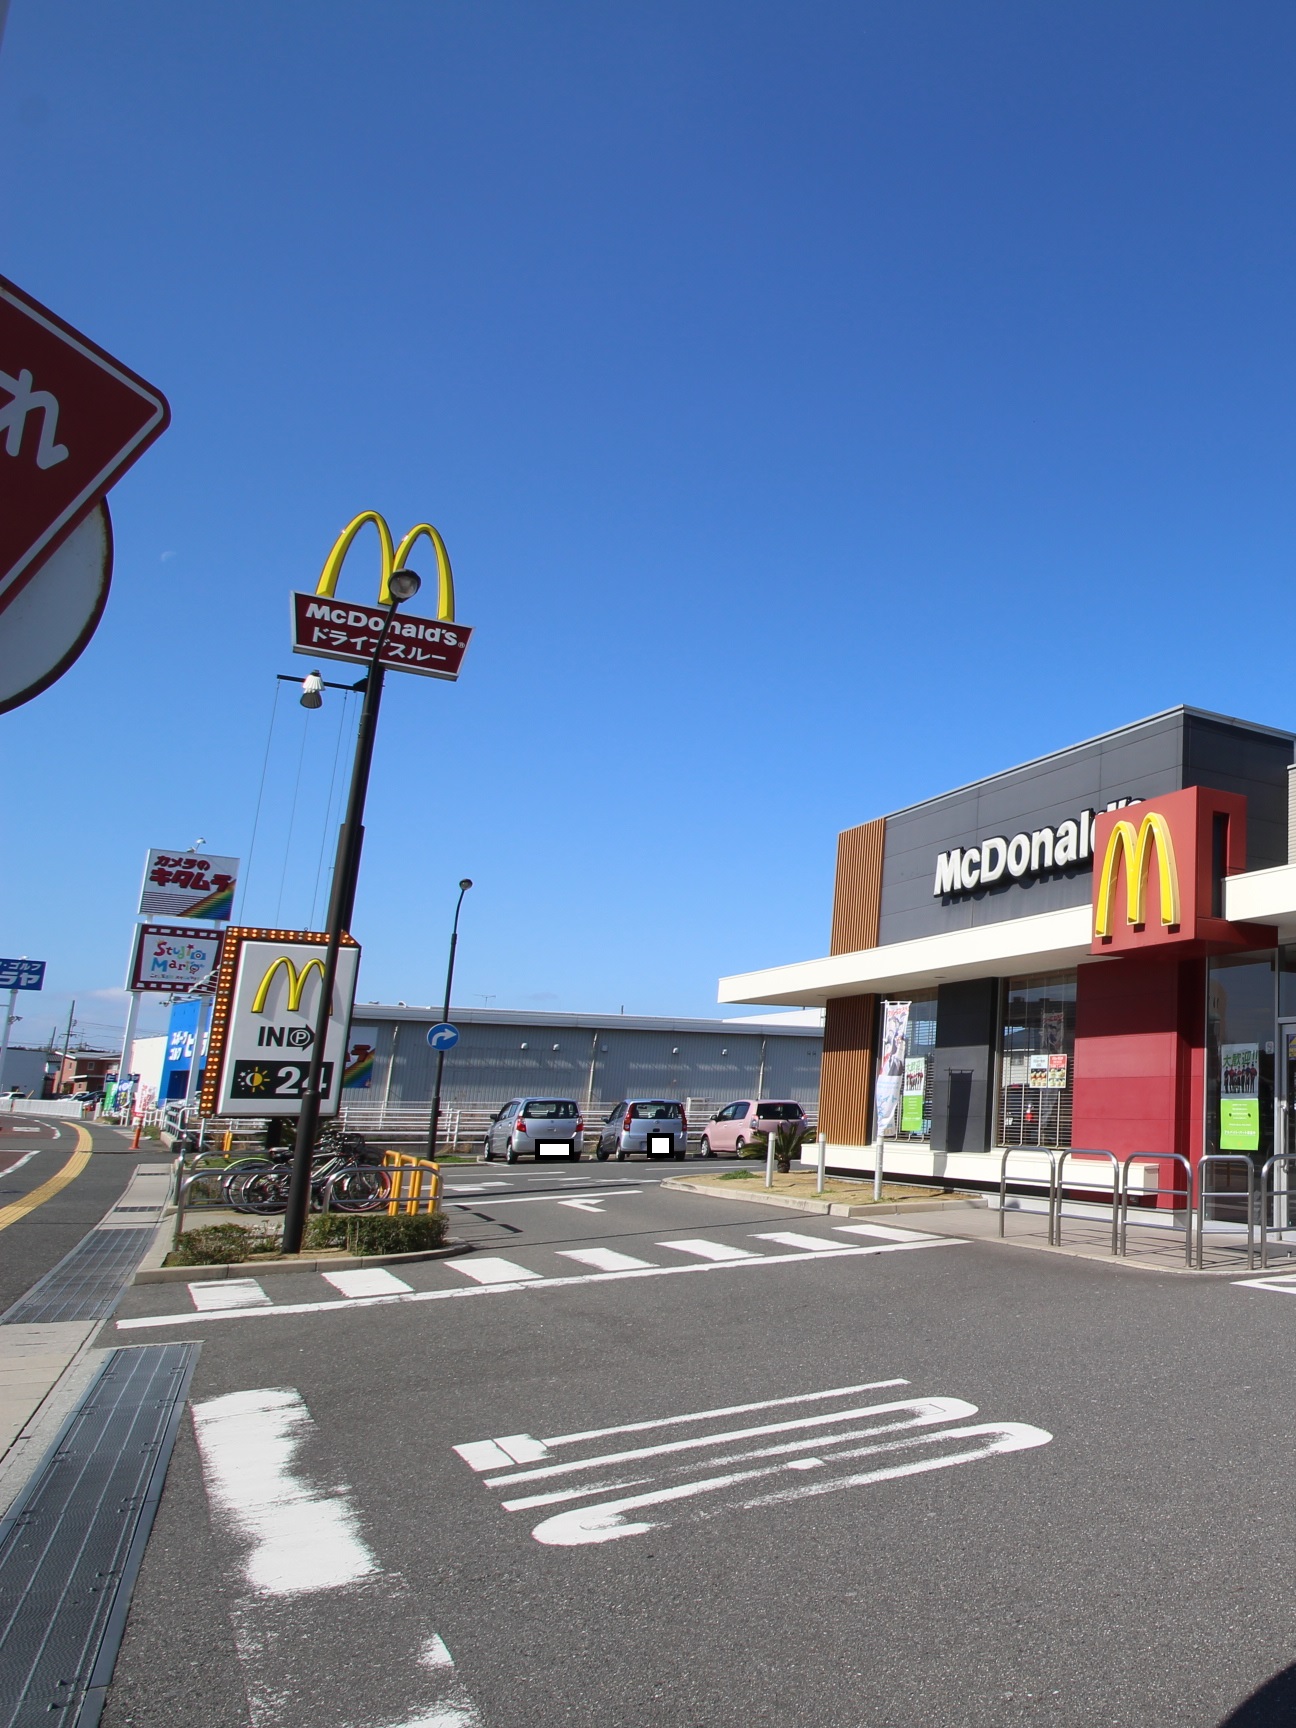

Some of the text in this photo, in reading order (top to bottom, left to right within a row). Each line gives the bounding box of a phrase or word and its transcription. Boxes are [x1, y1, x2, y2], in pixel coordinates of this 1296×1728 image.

[305, 602, 458, 647] McDonald's
[312, 626, 447, 662] ドライブスルー
[154, 855, 210, 871] カメラの
[149, 867, 233, 892] キタムラ
[0, 961, 42, 971] ・ゴルフ
[257, 1026, 286, 1047] IN
